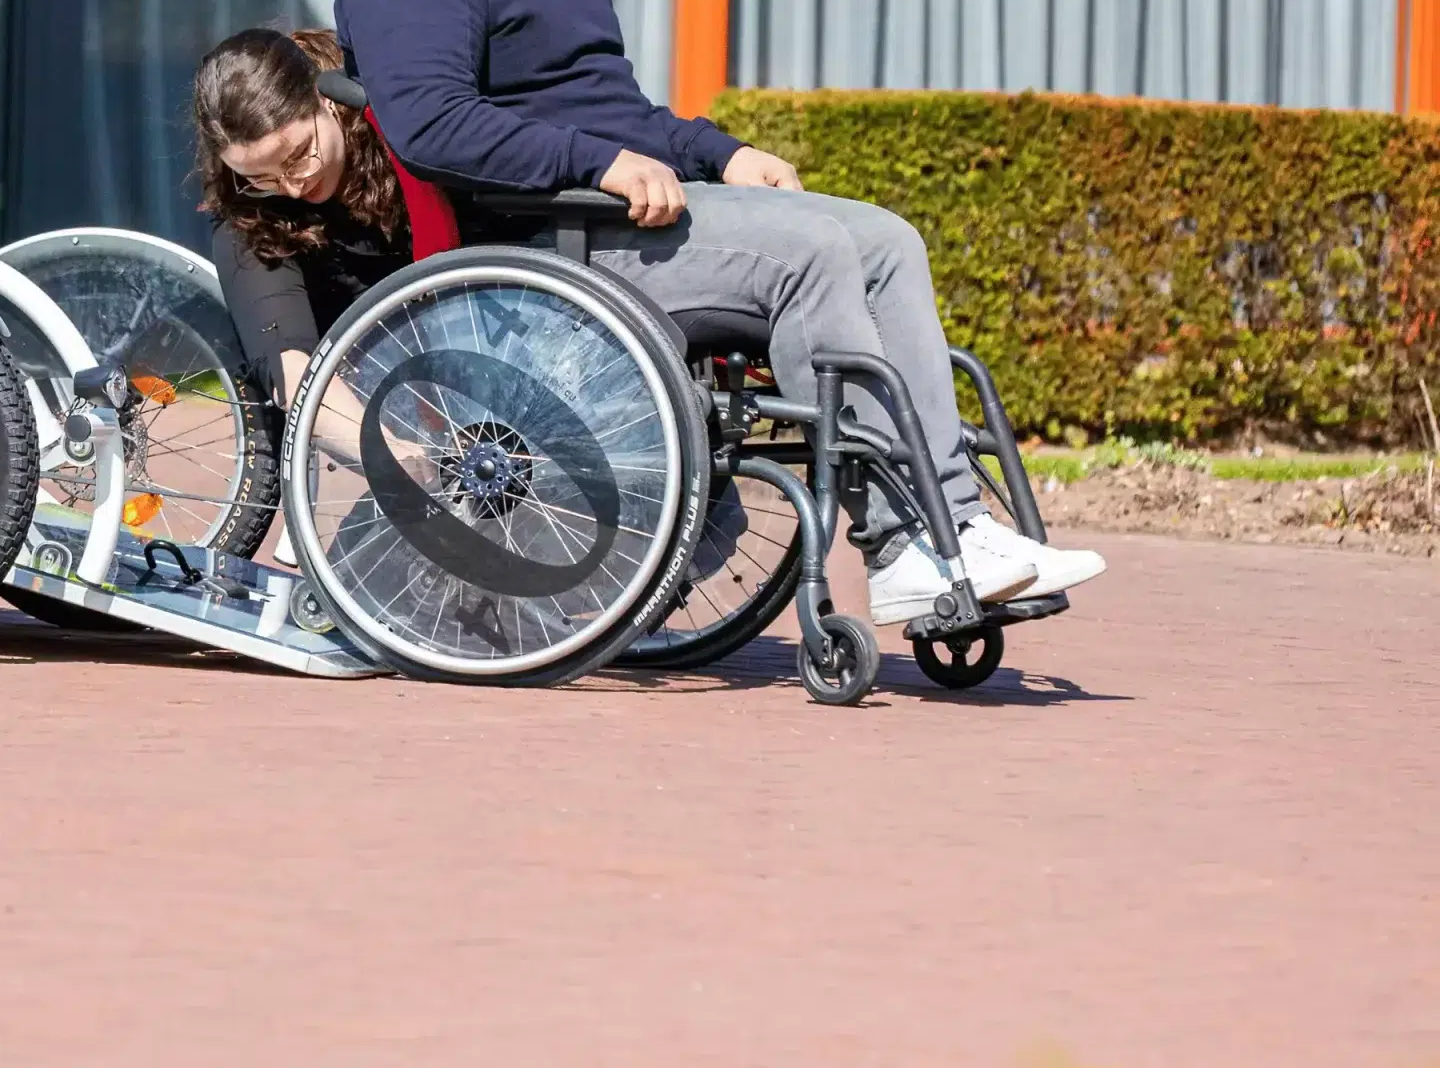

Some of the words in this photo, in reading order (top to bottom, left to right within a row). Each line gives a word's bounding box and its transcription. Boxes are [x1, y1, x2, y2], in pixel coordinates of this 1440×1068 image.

[282, 337, 333, 481] SCHWALBE
[633, 546, 687, 627] MARATHON
[682, 494, 700, 543] PLUS
